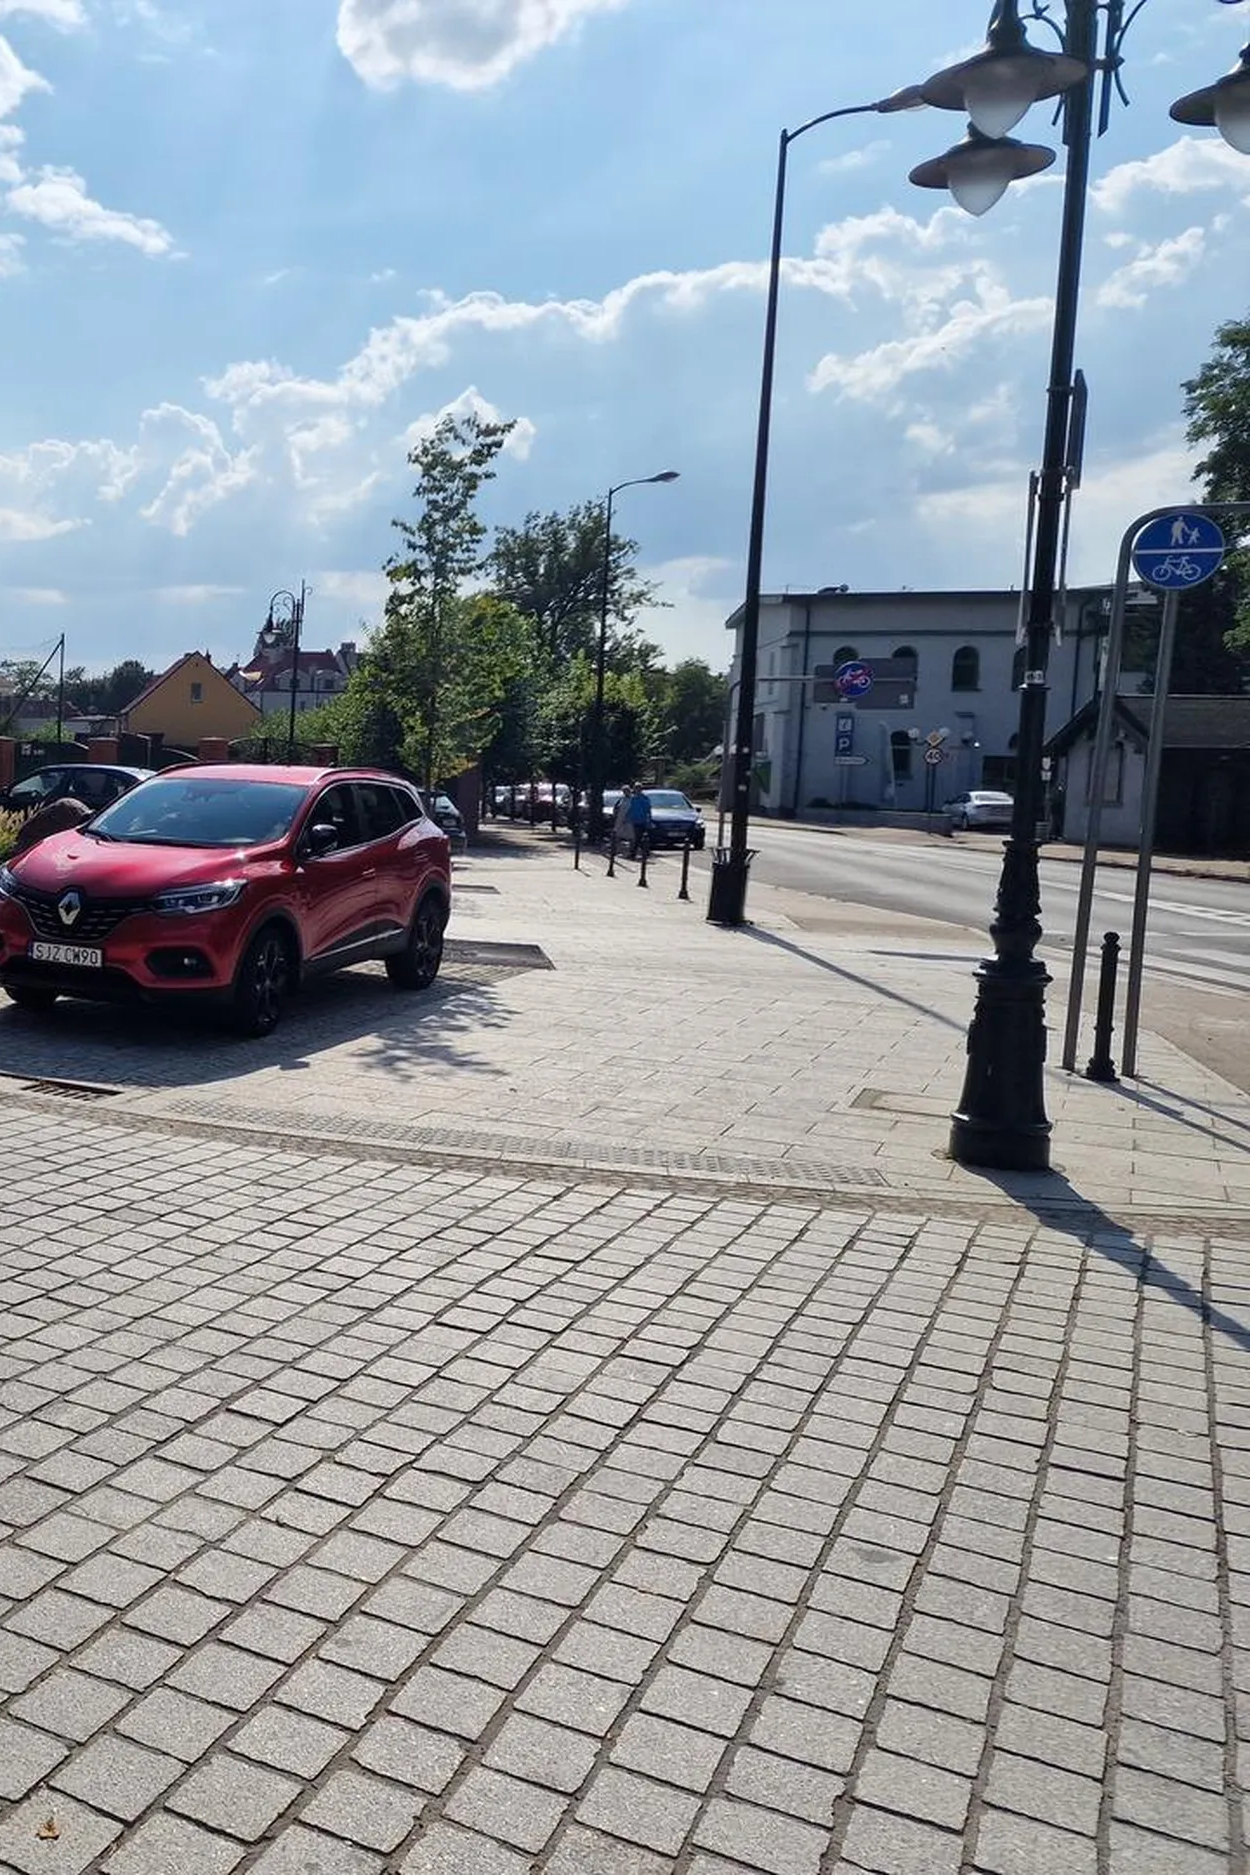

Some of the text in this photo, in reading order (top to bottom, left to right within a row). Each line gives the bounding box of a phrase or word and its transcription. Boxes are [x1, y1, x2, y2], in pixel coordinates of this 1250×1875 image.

[838, 737, 850, 751] P
[926, 751, 942, 760] 40
[35, 944, 99, 965] SJZ CW90
